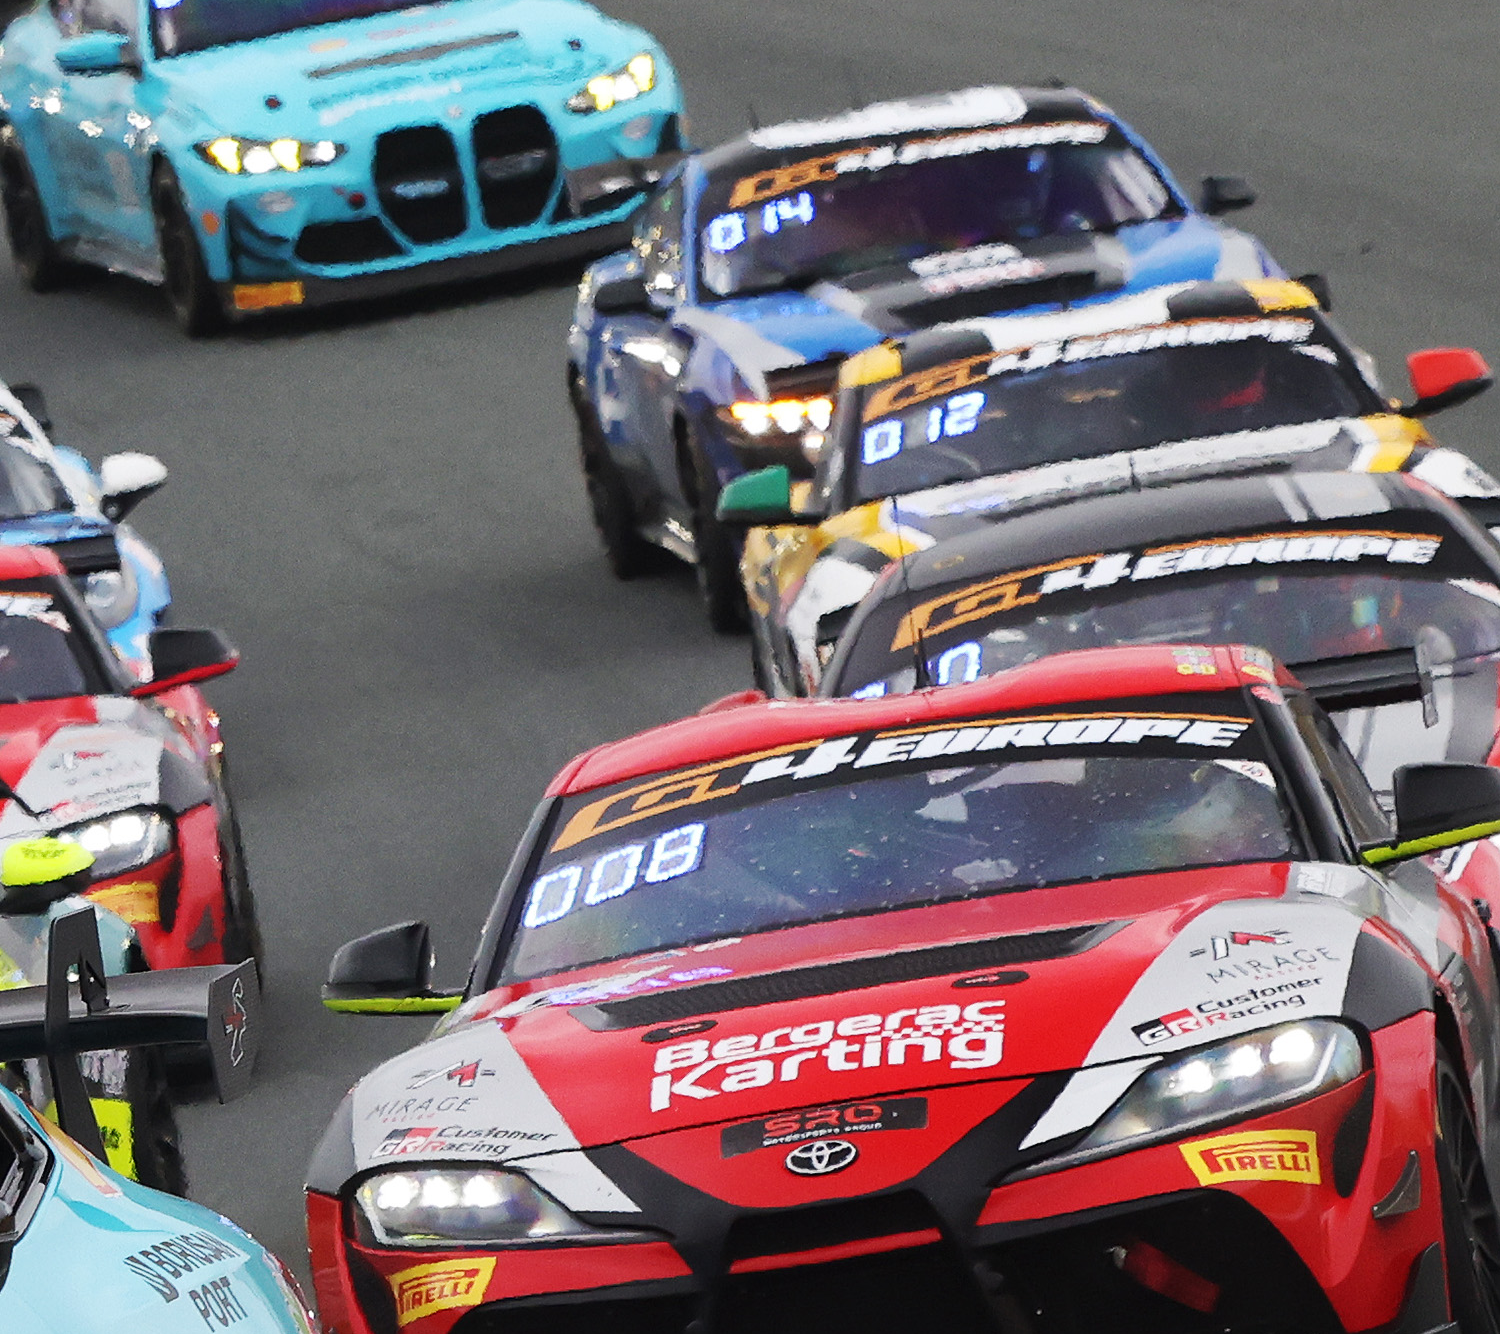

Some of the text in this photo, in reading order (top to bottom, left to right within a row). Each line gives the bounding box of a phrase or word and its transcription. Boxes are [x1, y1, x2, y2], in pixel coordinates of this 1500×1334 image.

[1129, 535, 1442, 582] EUROPE
[851, 719, 1250, 768] EUROPE
[523, 823, 704, 929] 008
[1206, 947, 1340, 984] MIRAGE
[1196, 976, 1323, 1014] Customer
[1202, 994, 1306, 1027] Racing
[653, 999, 1006, 1073] Bergerac
[650, 1031, 1005, 1113] Karting
[366, 1097, 479, 1120] MIRAGE
[762, 1101, 883, 1138] SRO
[419, 1140, 511, 1157] Racing
[437, 1124, 558, 1142] Customer
[1199, 1140, 1312, 1175] PIRELLI
[138, 1230, 241, 1280] BORUSAN
[188, 1275, 249, 1333] PORT
[399, 1268, 481, 1316] PIRELLI
